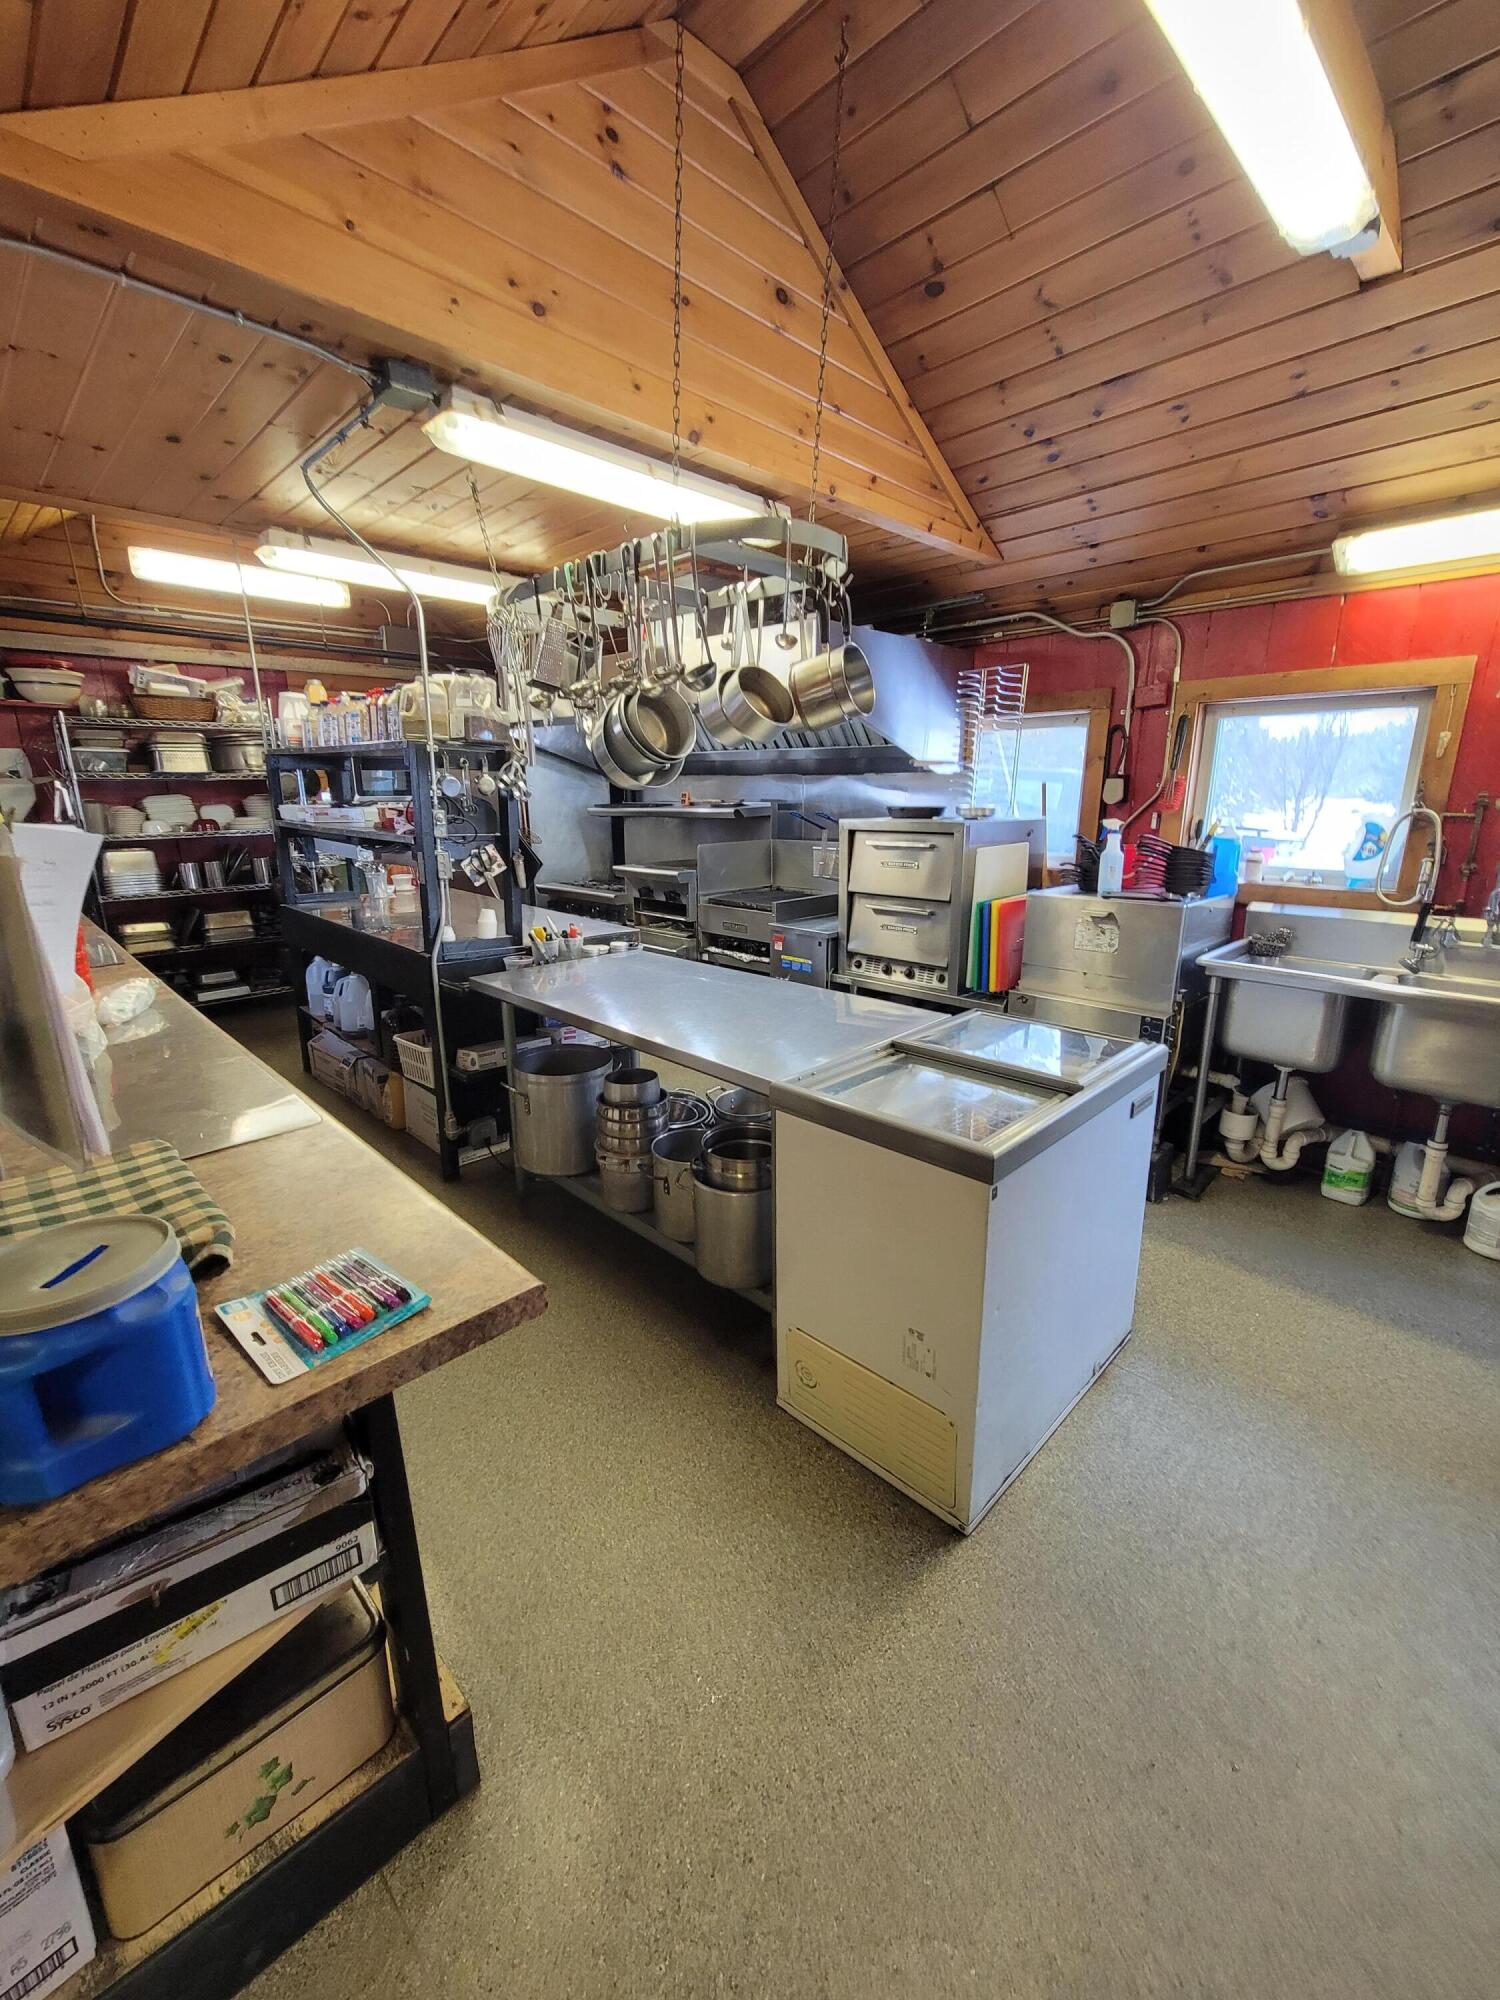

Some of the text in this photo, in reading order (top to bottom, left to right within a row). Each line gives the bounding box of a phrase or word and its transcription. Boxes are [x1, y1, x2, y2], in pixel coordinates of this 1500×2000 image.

[42, 1701, 54, 1712] 12
[79, 1676, 104, 1692] 2000
[106, 1668, 118, 1679] FT
